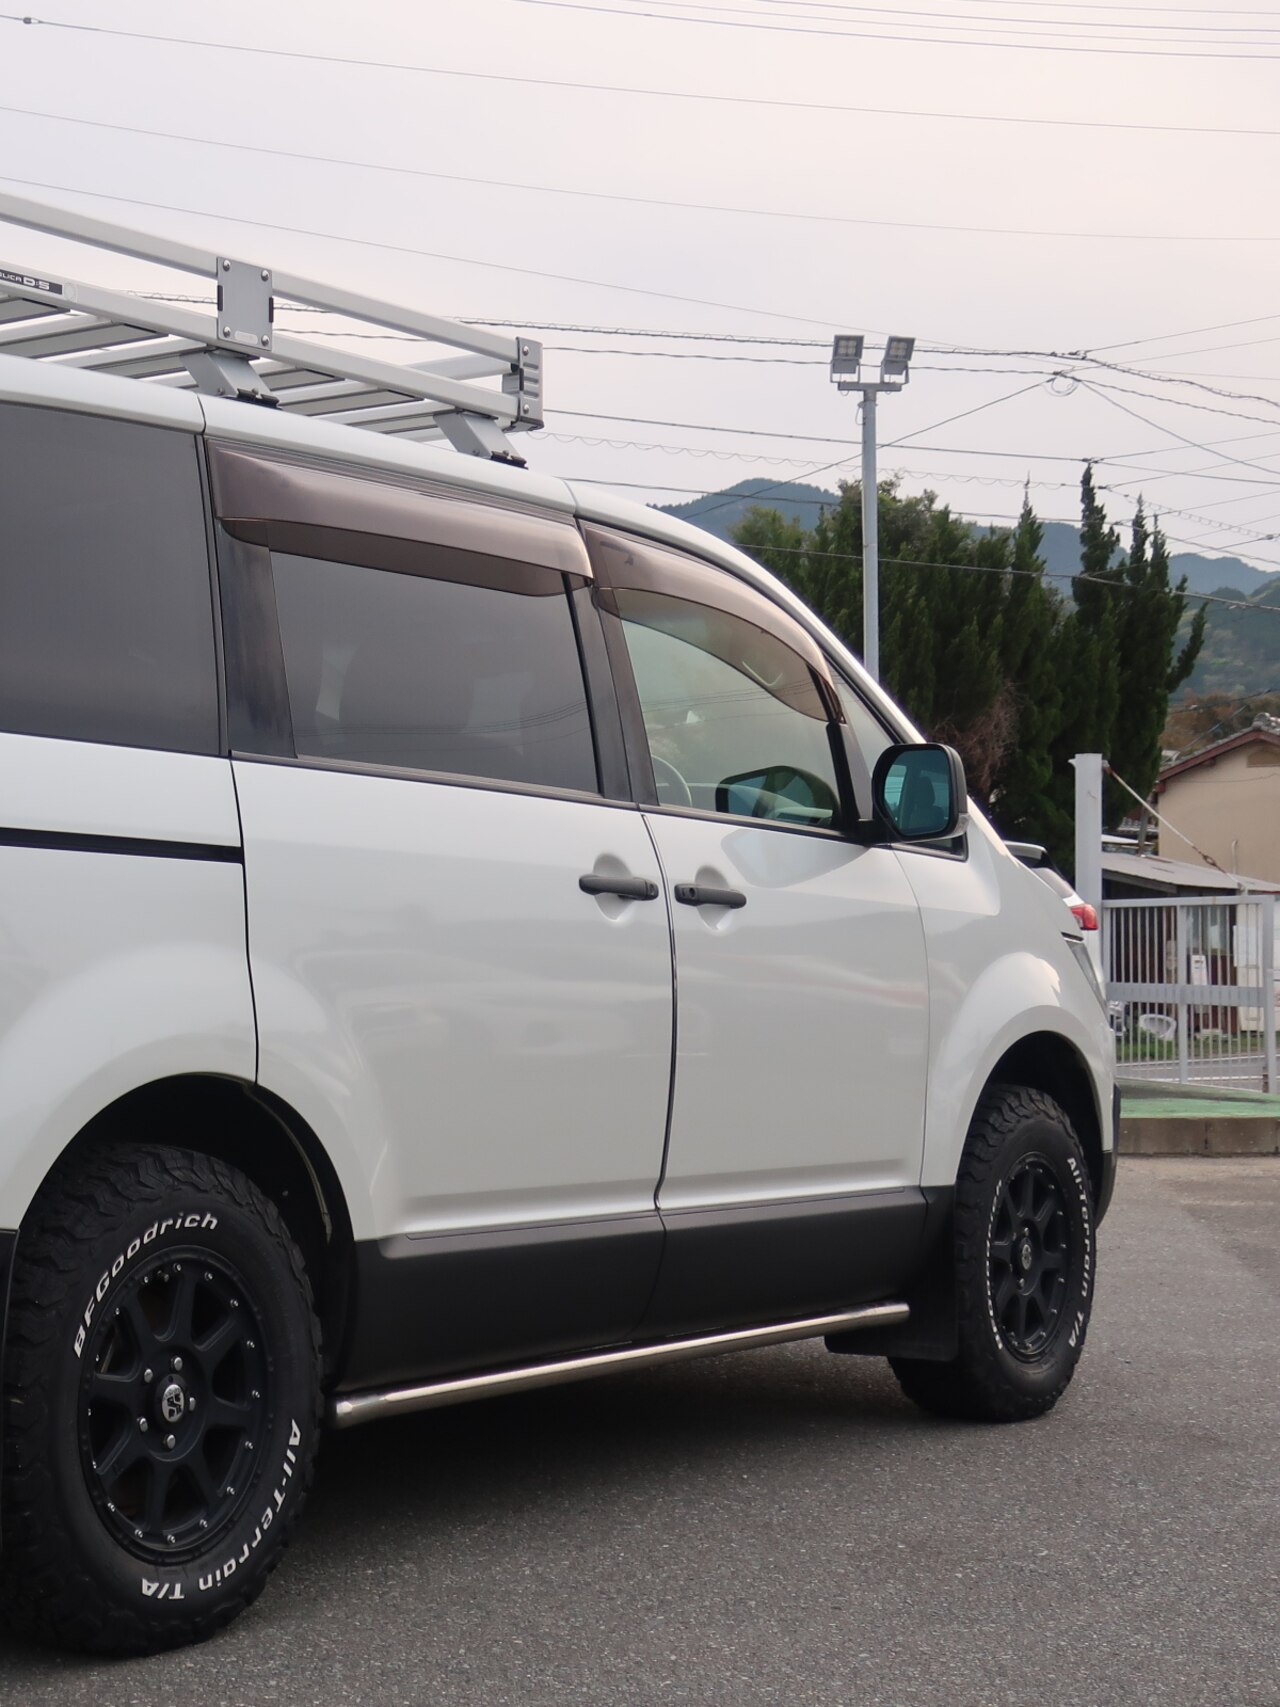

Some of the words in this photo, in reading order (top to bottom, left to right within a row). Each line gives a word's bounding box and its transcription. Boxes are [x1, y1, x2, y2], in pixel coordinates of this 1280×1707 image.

[74, 1212, 218, 1358] BFGoodrich
[198, 1418, 302, 1591] All-Terrain
[141, 1578, 185, 1600] T/A
